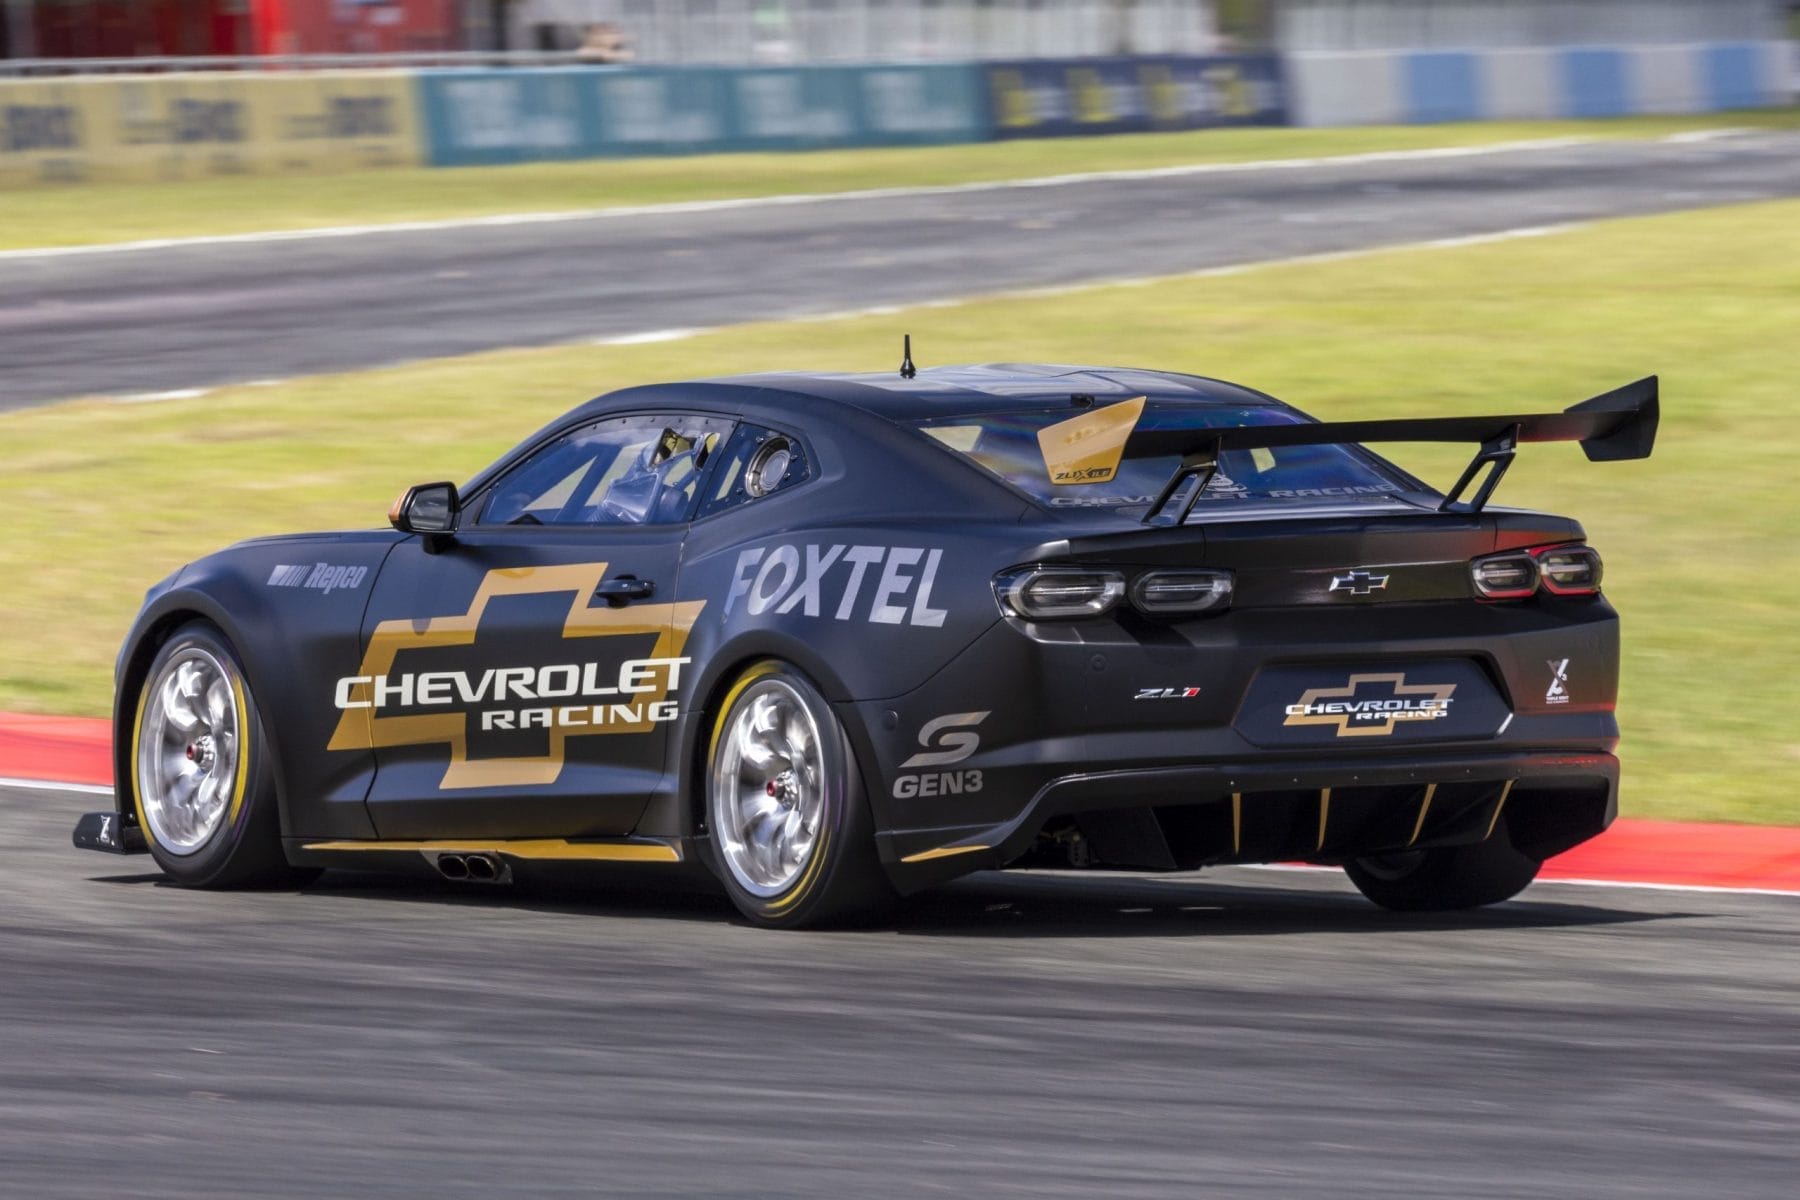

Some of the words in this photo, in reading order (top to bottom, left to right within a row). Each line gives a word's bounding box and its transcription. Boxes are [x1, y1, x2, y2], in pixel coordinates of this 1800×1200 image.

[1268, 484, 1398, 498] RACING
[303, 562, 368, 595] Repco
[721, 544, 948, 628] FOXTEL
[334, 656, 691, 709] CHEVROLET
[1134, 686, 1201, 699] ZL1
[481, 700, 679, 731] RACING
[1285, 698, 1454, 716] CHEVROLET
[1355, 710, 1448, 720] RACING
[892, 769, 984, 799] GEN3
